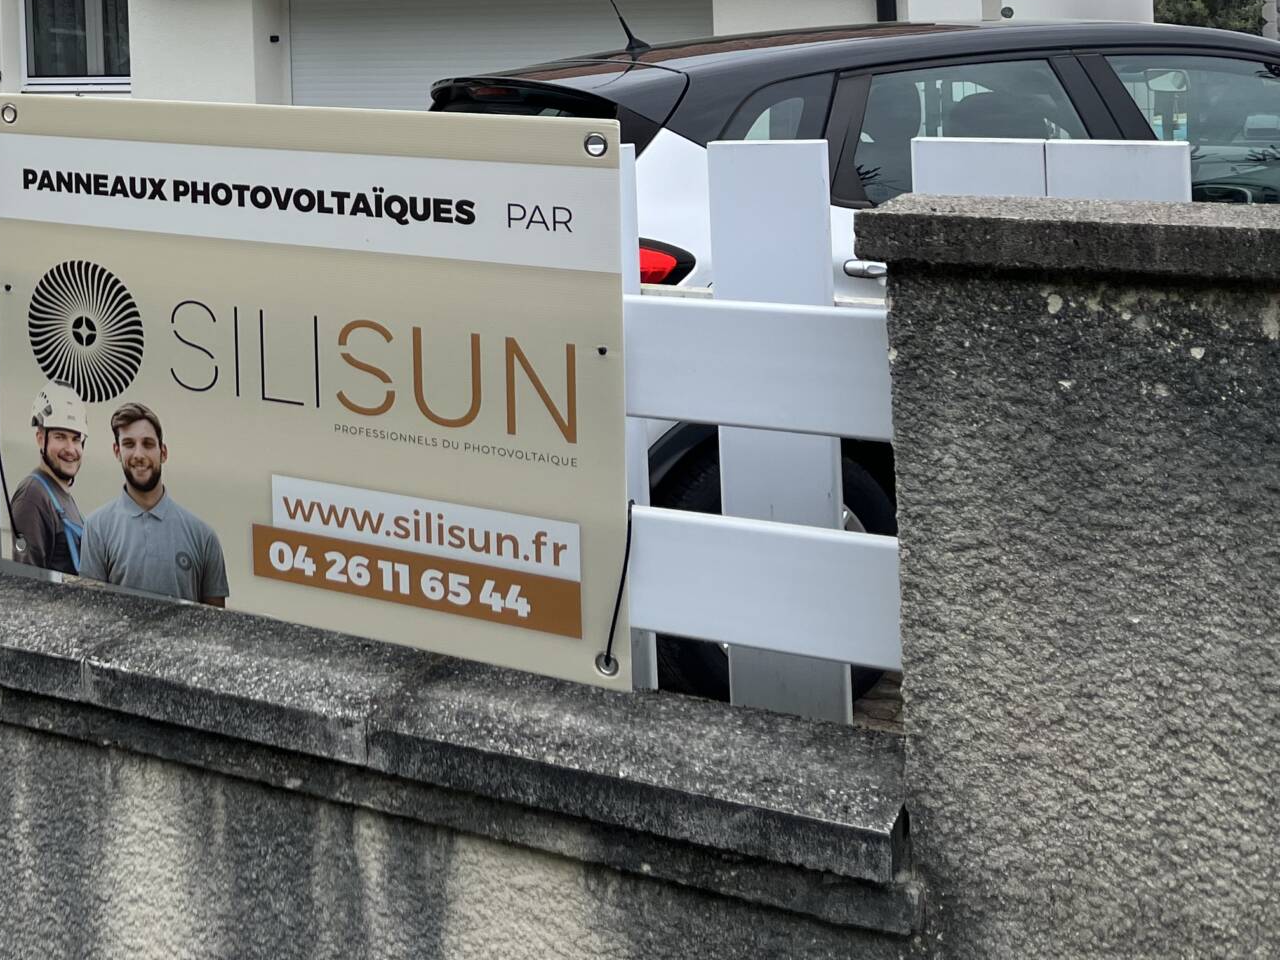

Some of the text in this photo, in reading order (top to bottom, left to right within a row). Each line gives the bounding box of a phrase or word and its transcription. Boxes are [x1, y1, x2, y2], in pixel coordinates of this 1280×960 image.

[22, 167, 573, 233] PANNEAUX PHOTOVOLTAÏQUES PAR
[170, 299, 578, 445] SILISUN
[334, 423, 578, 468] PROFESSIONNELS DU PHOTOVOLTAÏQUE
[281, 495, 568, 567] www.silisun.fr
[268, 540, 532, 618] 04 26 11 65 44
